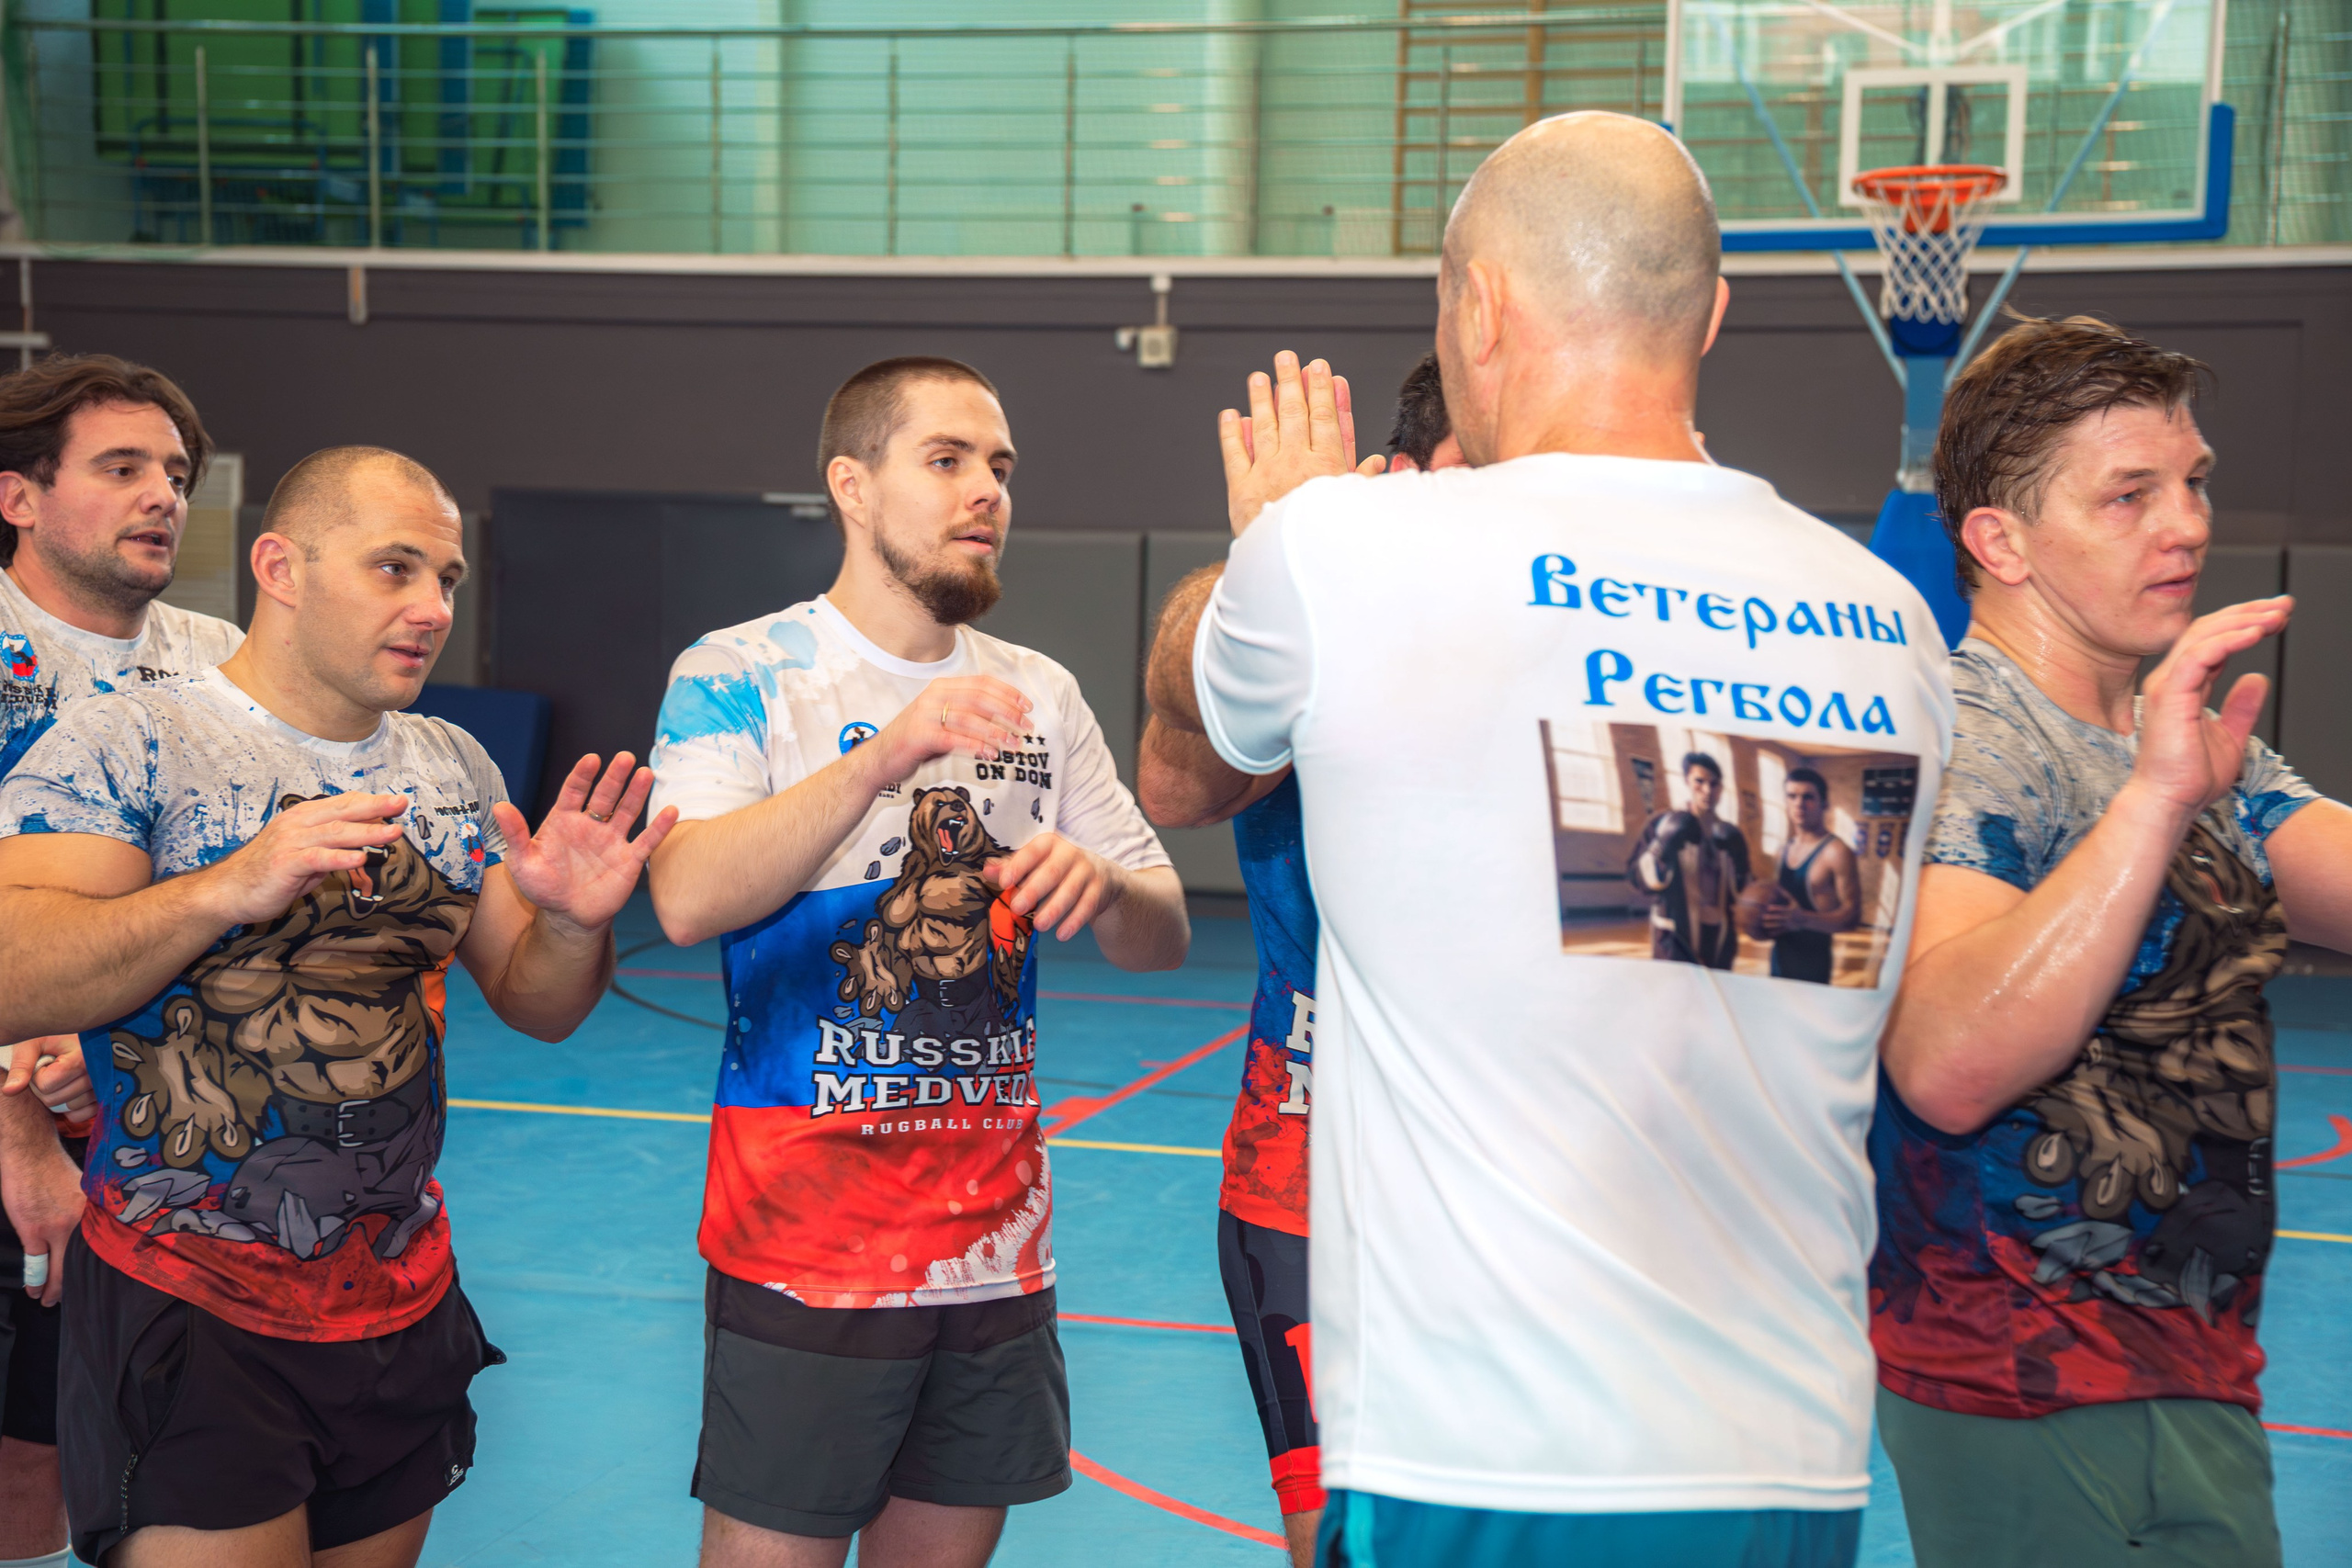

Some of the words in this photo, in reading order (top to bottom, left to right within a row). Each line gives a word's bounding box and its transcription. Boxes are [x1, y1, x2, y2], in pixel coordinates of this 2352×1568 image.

[975, 750, 1049, 769] STOV
[976, 763, 1005, 781] ON
[1015, 767, 1052, 789] DON
[813, 1015, 1035, 1067] RUSSKIE
[861, 1118, 972, 1135] RUGBALL
[982, 1118, 1023, 1130] CLUB
